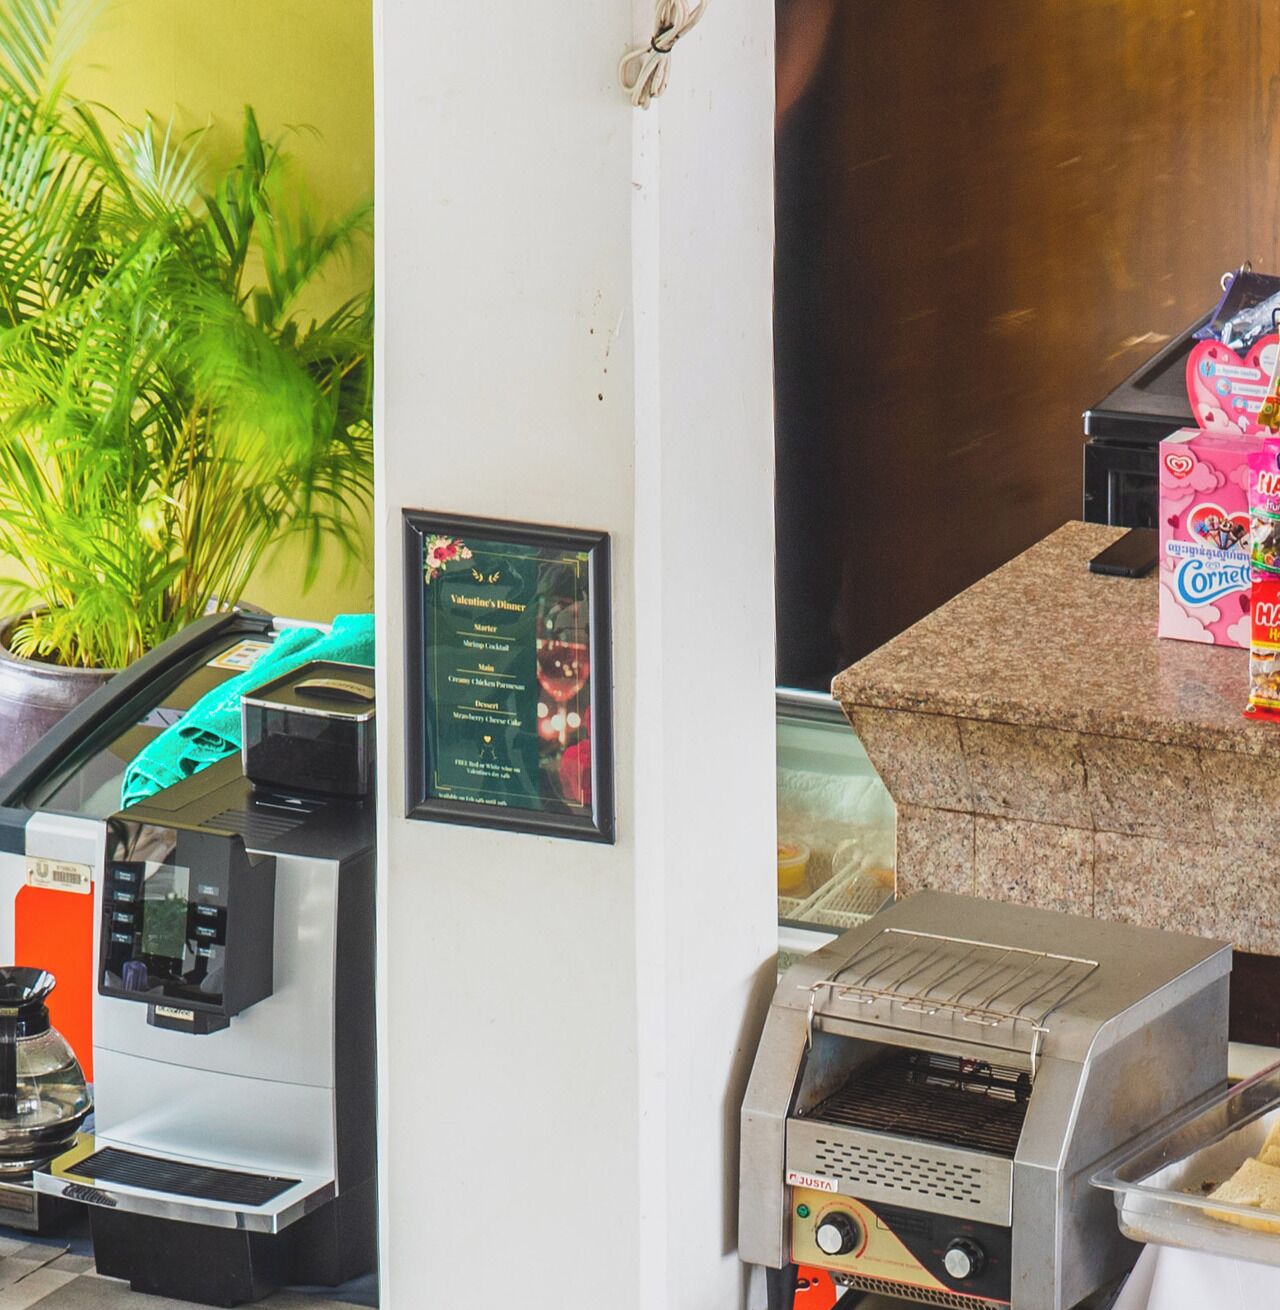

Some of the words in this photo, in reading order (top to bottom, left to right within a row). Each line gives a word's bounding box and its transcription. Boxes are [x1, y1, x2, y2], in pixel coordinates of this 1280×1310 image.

[1177, 559, 1252, 604] Cornett
[450, 594, 496, 608] Valentine's
[497, 599, 527, 613] Dinner
[474, 623, 498, 633] Starter
[478, 663, 495, 673] Main
[475, 699, 499, 710] Dessert
[799, 1175, 832, 1191] JUSTA
